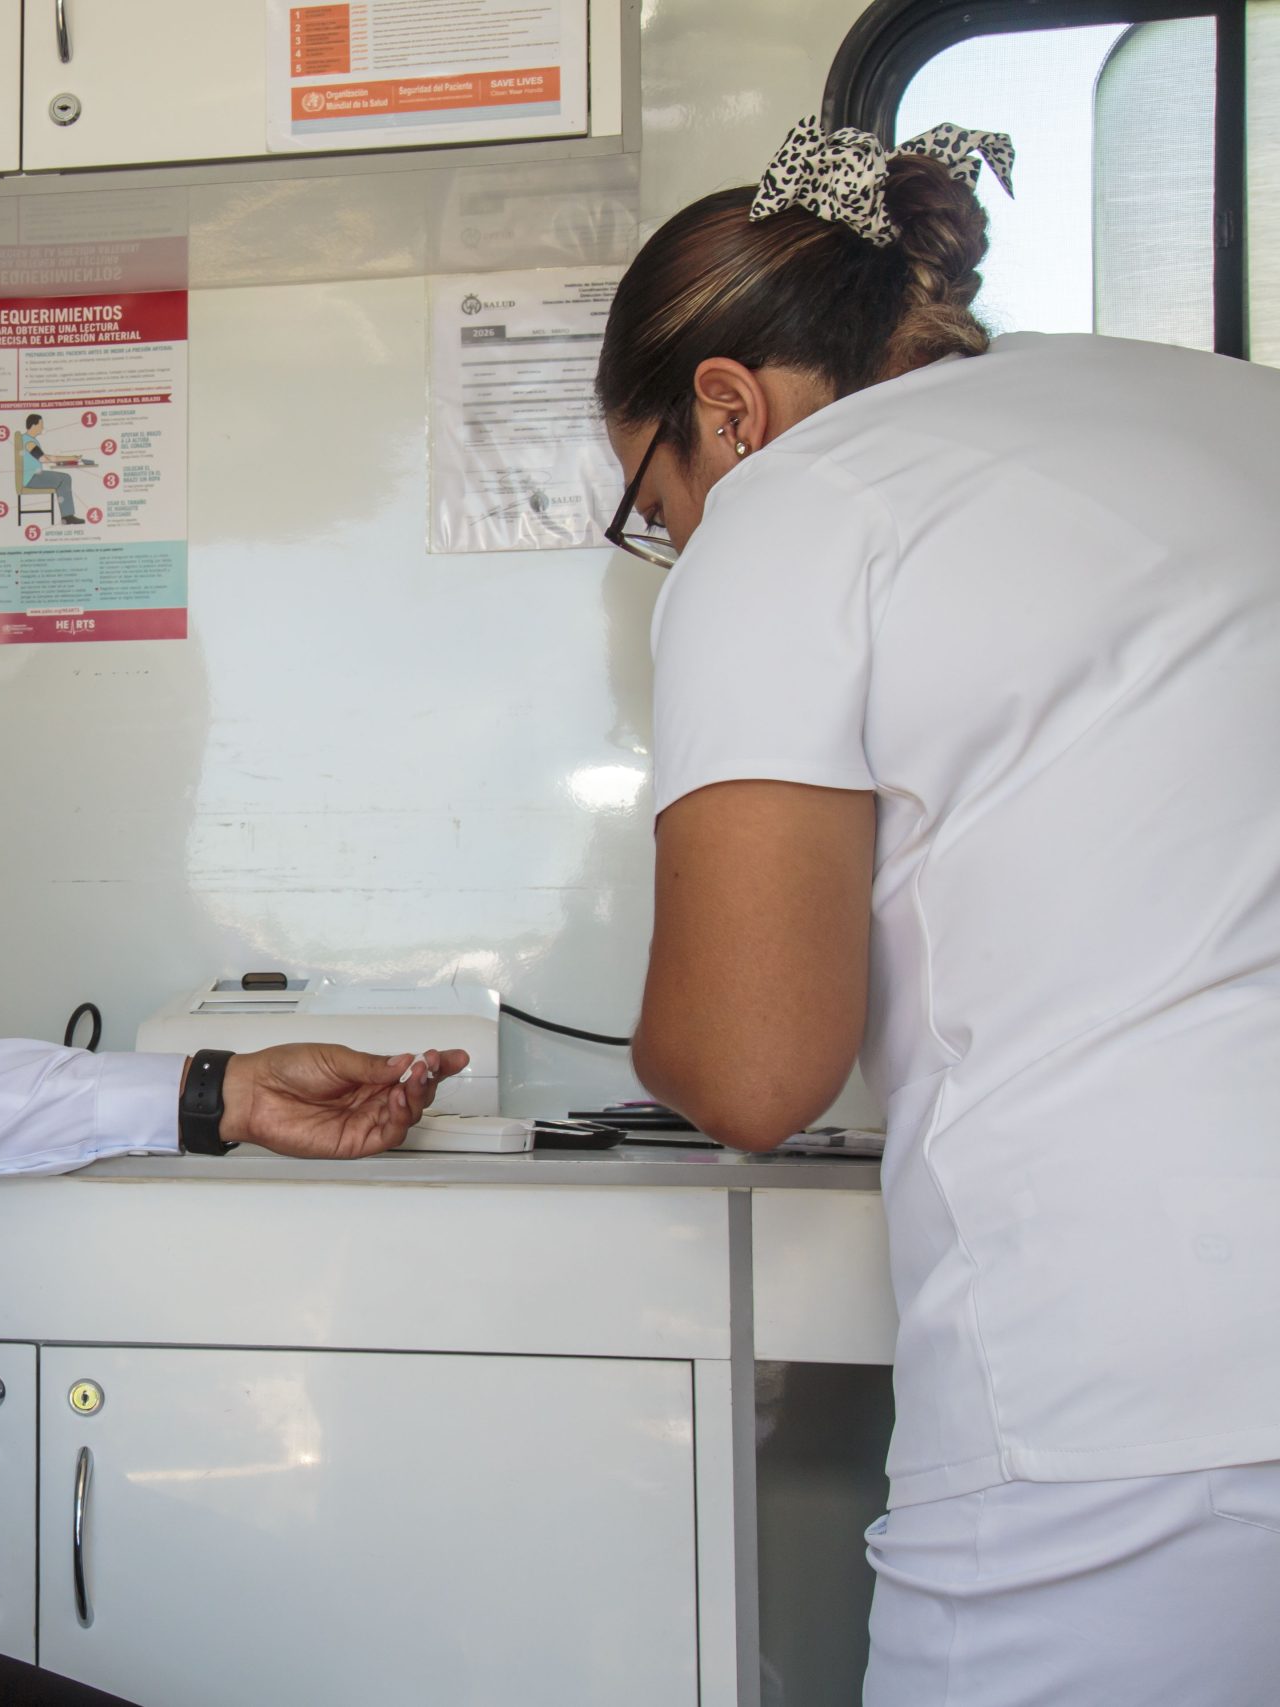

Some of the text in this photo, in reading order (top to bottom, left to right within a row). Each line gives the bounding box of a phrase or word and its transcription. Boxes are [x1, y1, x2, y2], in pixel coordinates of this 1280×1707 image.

[491, 77, 544, 88] SAVE LIVES
[326, 89, 368, 100] Organización
[399, 82, 472, 96] Seguridad del Paciente
[362, 100, 368, 108] la
[370, 99, 388, 107] Salud
[484, 301, 515, 309] SALUD
[16, 325, 56, 334] OBTENER
[58, 324, 76, 333] UNA
[80, 322, 119, 332] LECTURA
[473, 329, 495, 337] 2026
[30, 335, 41, 344] DE
[44, 334, 55, 343] LA
[58, 332, 95, 343] PRESIÓN
[98, 331, 141, 341] ARTERIAL
